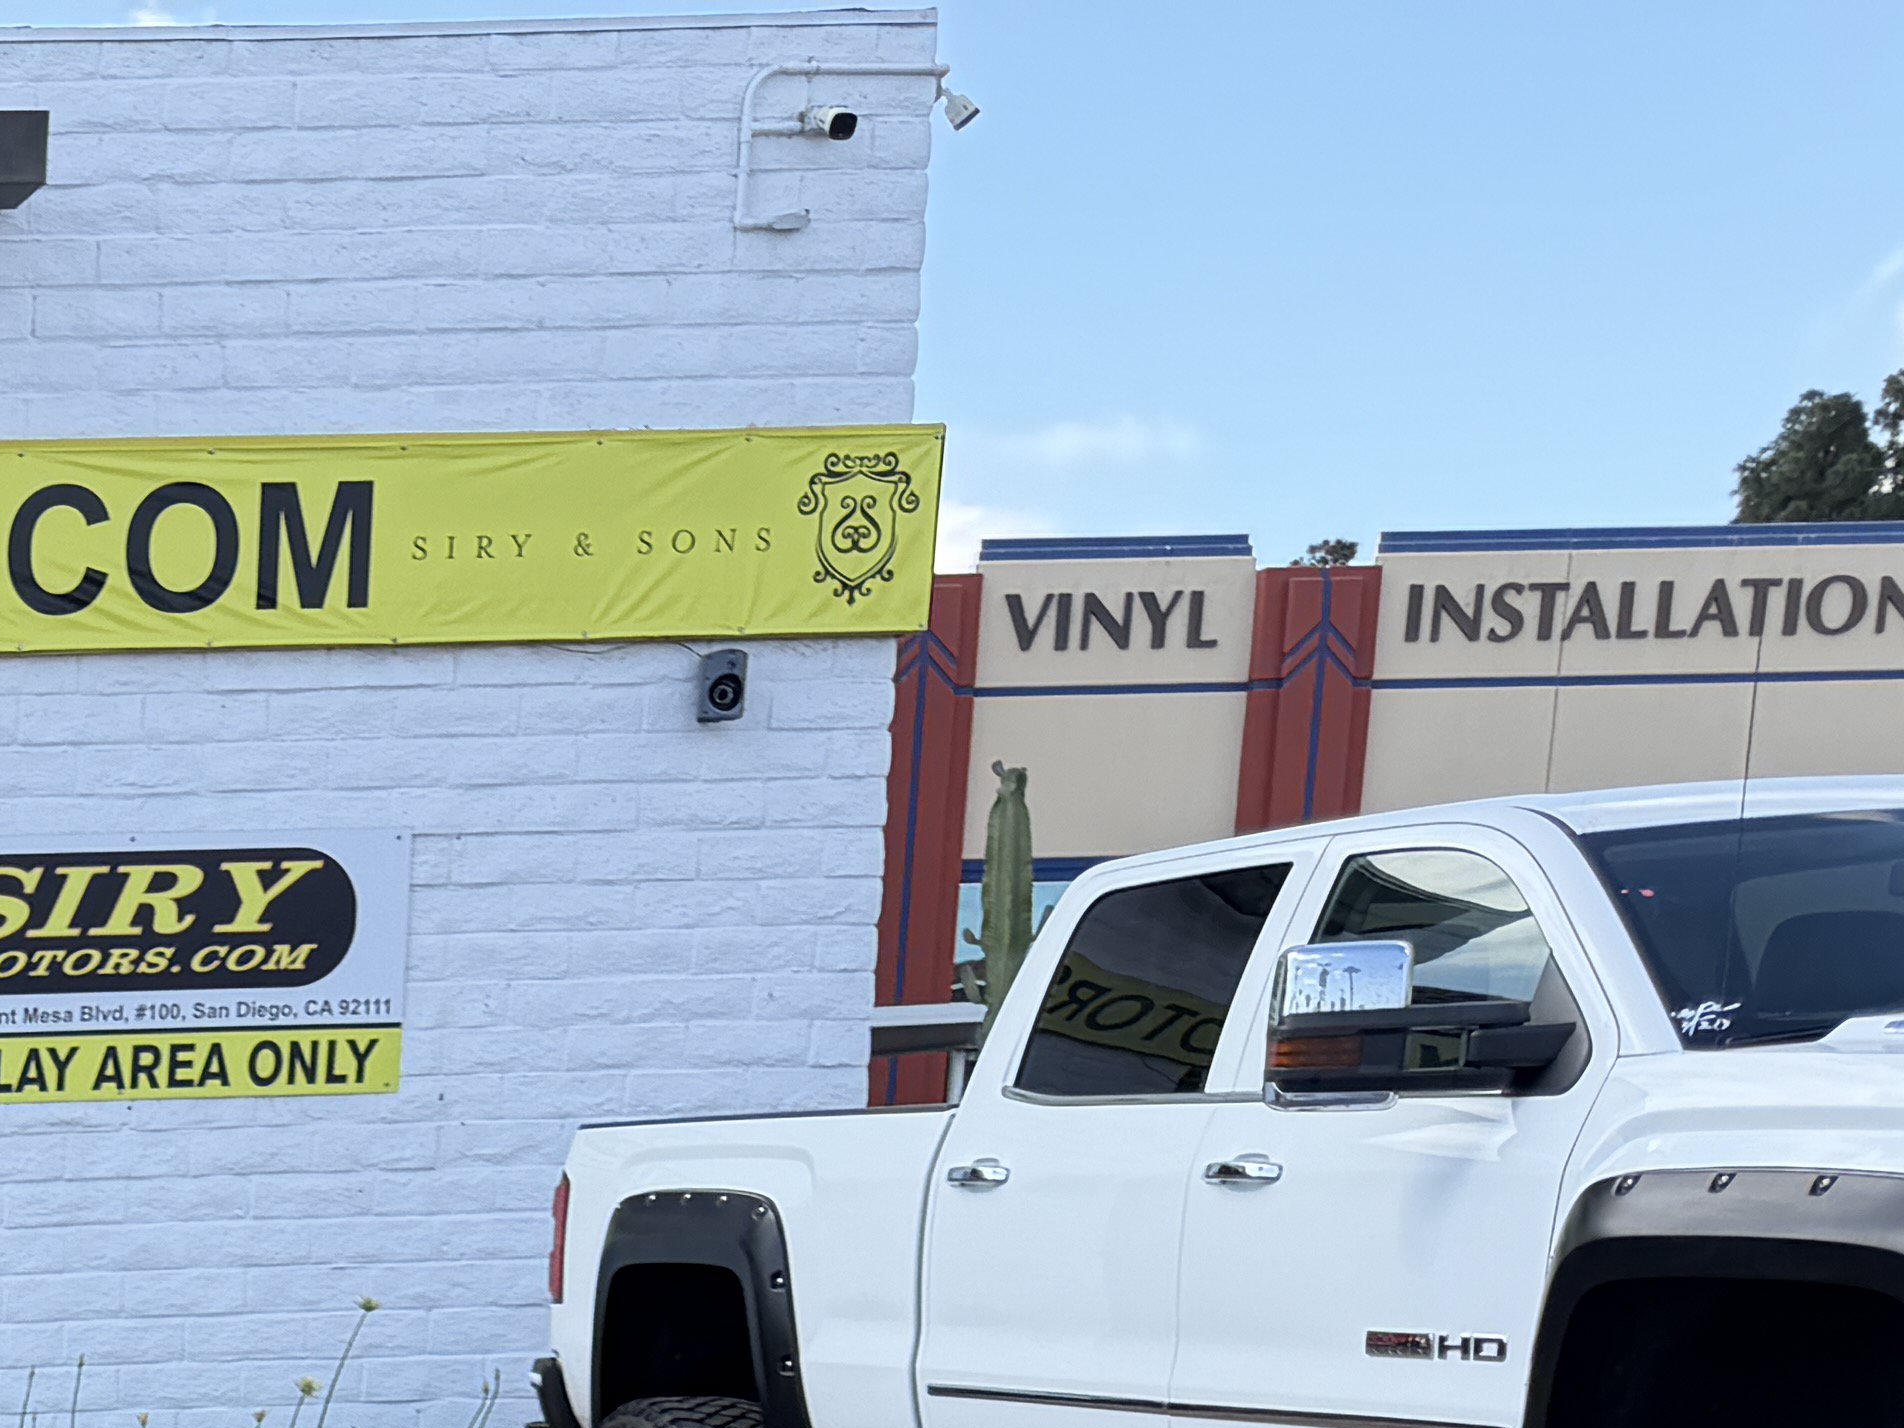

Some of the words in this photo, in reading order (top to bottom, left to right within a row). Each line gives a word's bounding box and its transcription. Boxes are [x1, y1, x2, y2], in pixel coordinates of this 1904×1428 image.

[412, 532, 535, 561] SIRY
[574, 530, 594, 556] &
[637, 527, 774, 555] SONS
[1006, 589, 1218, 652] VINYL
[22, 1007, 73, 1024] Mesa
[134, 1004, 186, 1023] #100,
[192, 1002, 230, 1018] San
[236, 1001, 299, 1022] Diego,
[304, 1000, 333, 1016] CA
[337, 997, 392, 1015] 92111
[91, 1043, 230, 1091] AREA
[248, 1038, 380, 1087] ONLY
[1438, 1333, 1508, 1363] HD
